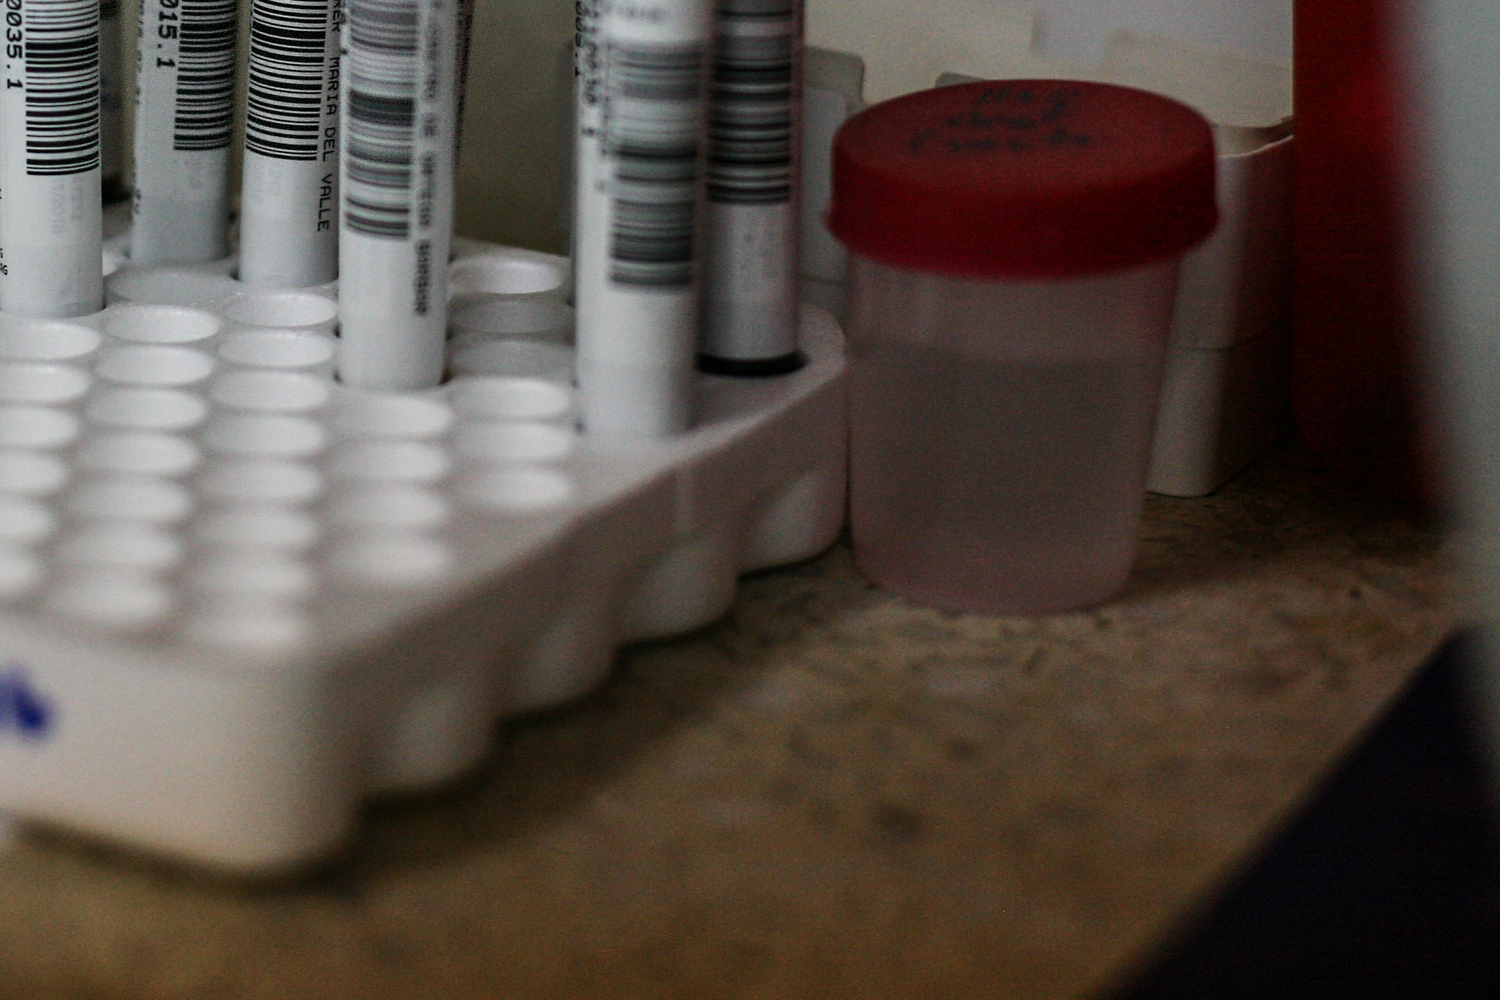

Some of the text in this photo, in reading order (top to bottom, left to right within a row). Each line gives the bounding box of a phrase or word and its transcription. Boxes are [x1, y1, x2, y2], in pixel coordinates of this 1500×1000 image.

[325, 56, 341, 116] MARIA
[322, 127, 336, 162] DEL
[317, 173, 333, 232] VALLE
